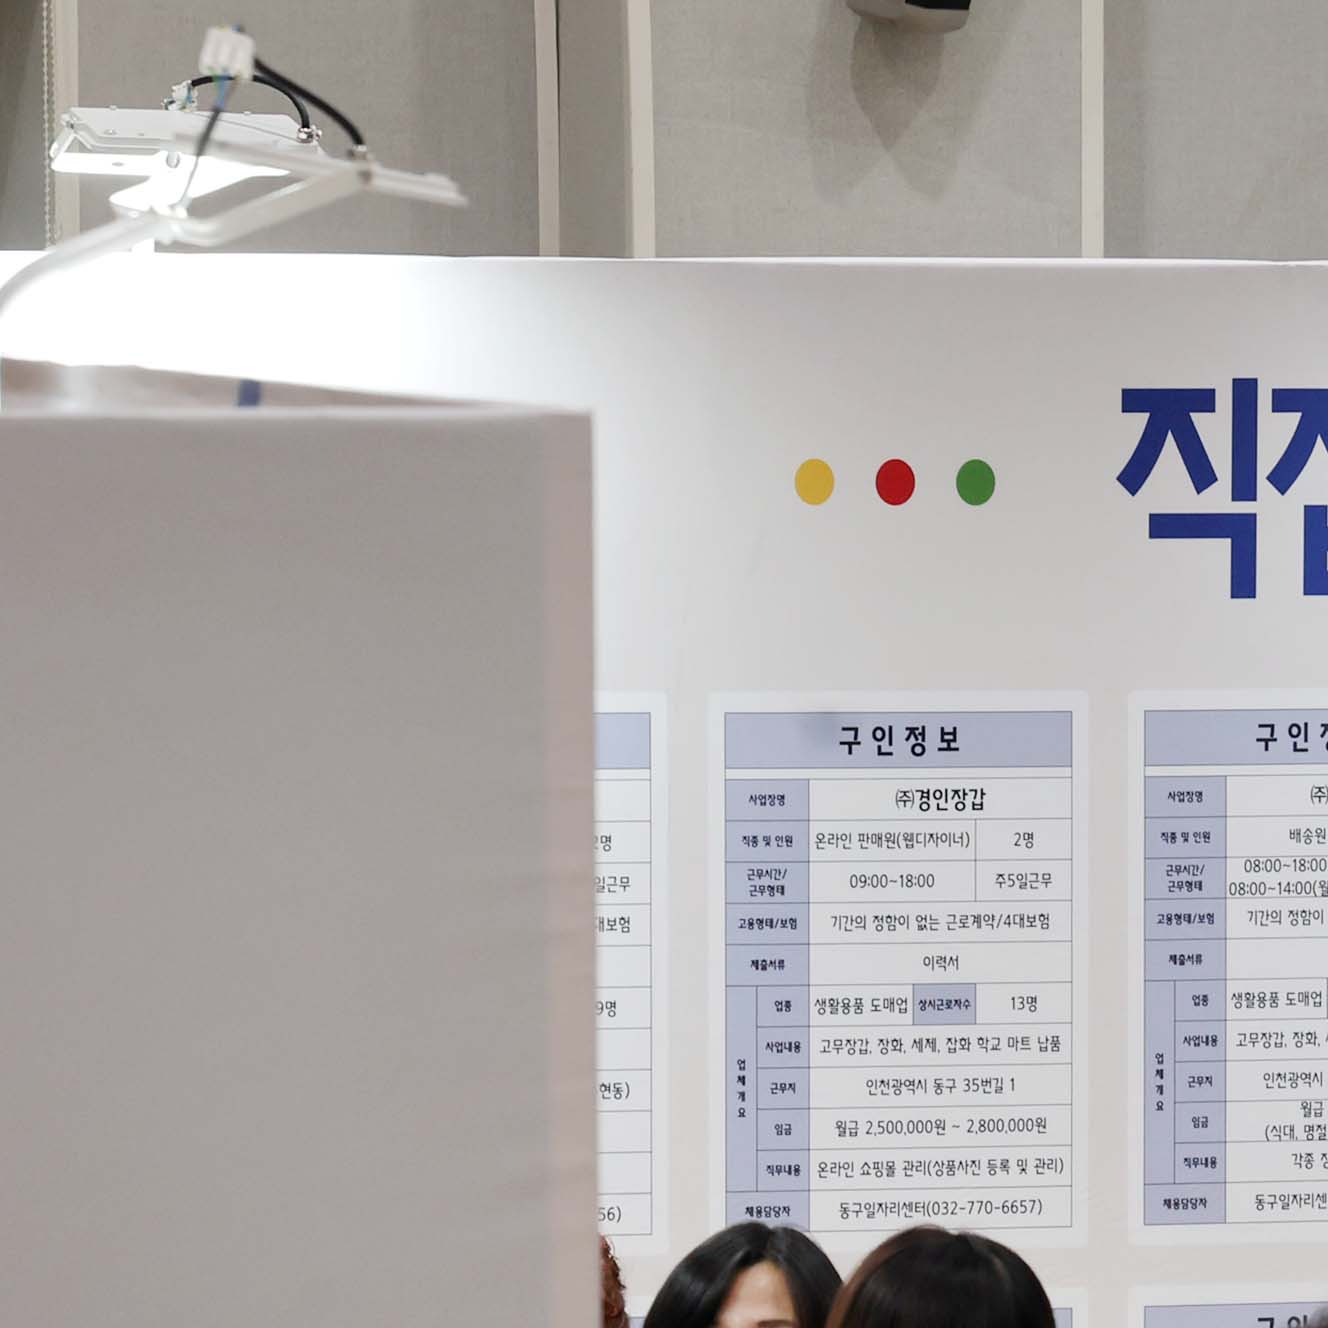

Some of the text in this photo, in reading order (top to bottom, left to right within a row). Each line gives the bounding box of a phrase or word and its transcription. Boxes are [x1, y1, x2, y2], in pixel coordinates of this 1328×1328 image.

[814, 831, 971, 850] 온라인 판매원(웹디자이너)
[1013, 831, 1034, 850] 2명
[1288, 827, 1327, 846] 배송원
[849, 873, 935, 889] 09:00~18:00
[995, 872, 1053, 890] 주5일근무
[831, 912, 1050, 933] 기간의 정함이 없는 근로계약/4대보험
[922, 954, 959, 972] 이력서
[814, 996, 908, 1016] 생활용품 도매업
[1010, 995, 1038, 1013] 13명
[819, 1035, 1062, 1056] 고무장갑, 장화, 세제, 잡화 학교 마트 납품
[865, 1078, 928, 1097] 인천광역시
[932, 1077, 957, 1096] 동구
[962, 1076, 1004, 1095] 35번길
[1262, 1071, 1323, 1090] 인천광역시
[1299, 1098, 1325, 1119] 월급
[835, 1120, 860, 1138] 월급
[865, 1118, 946, 1137] 2,500,000원
[966, 1116, 1047, 1135] 2,800,000원
[839, 1198, 1043, 1220] 동구일자리센터(032-770-6657)
